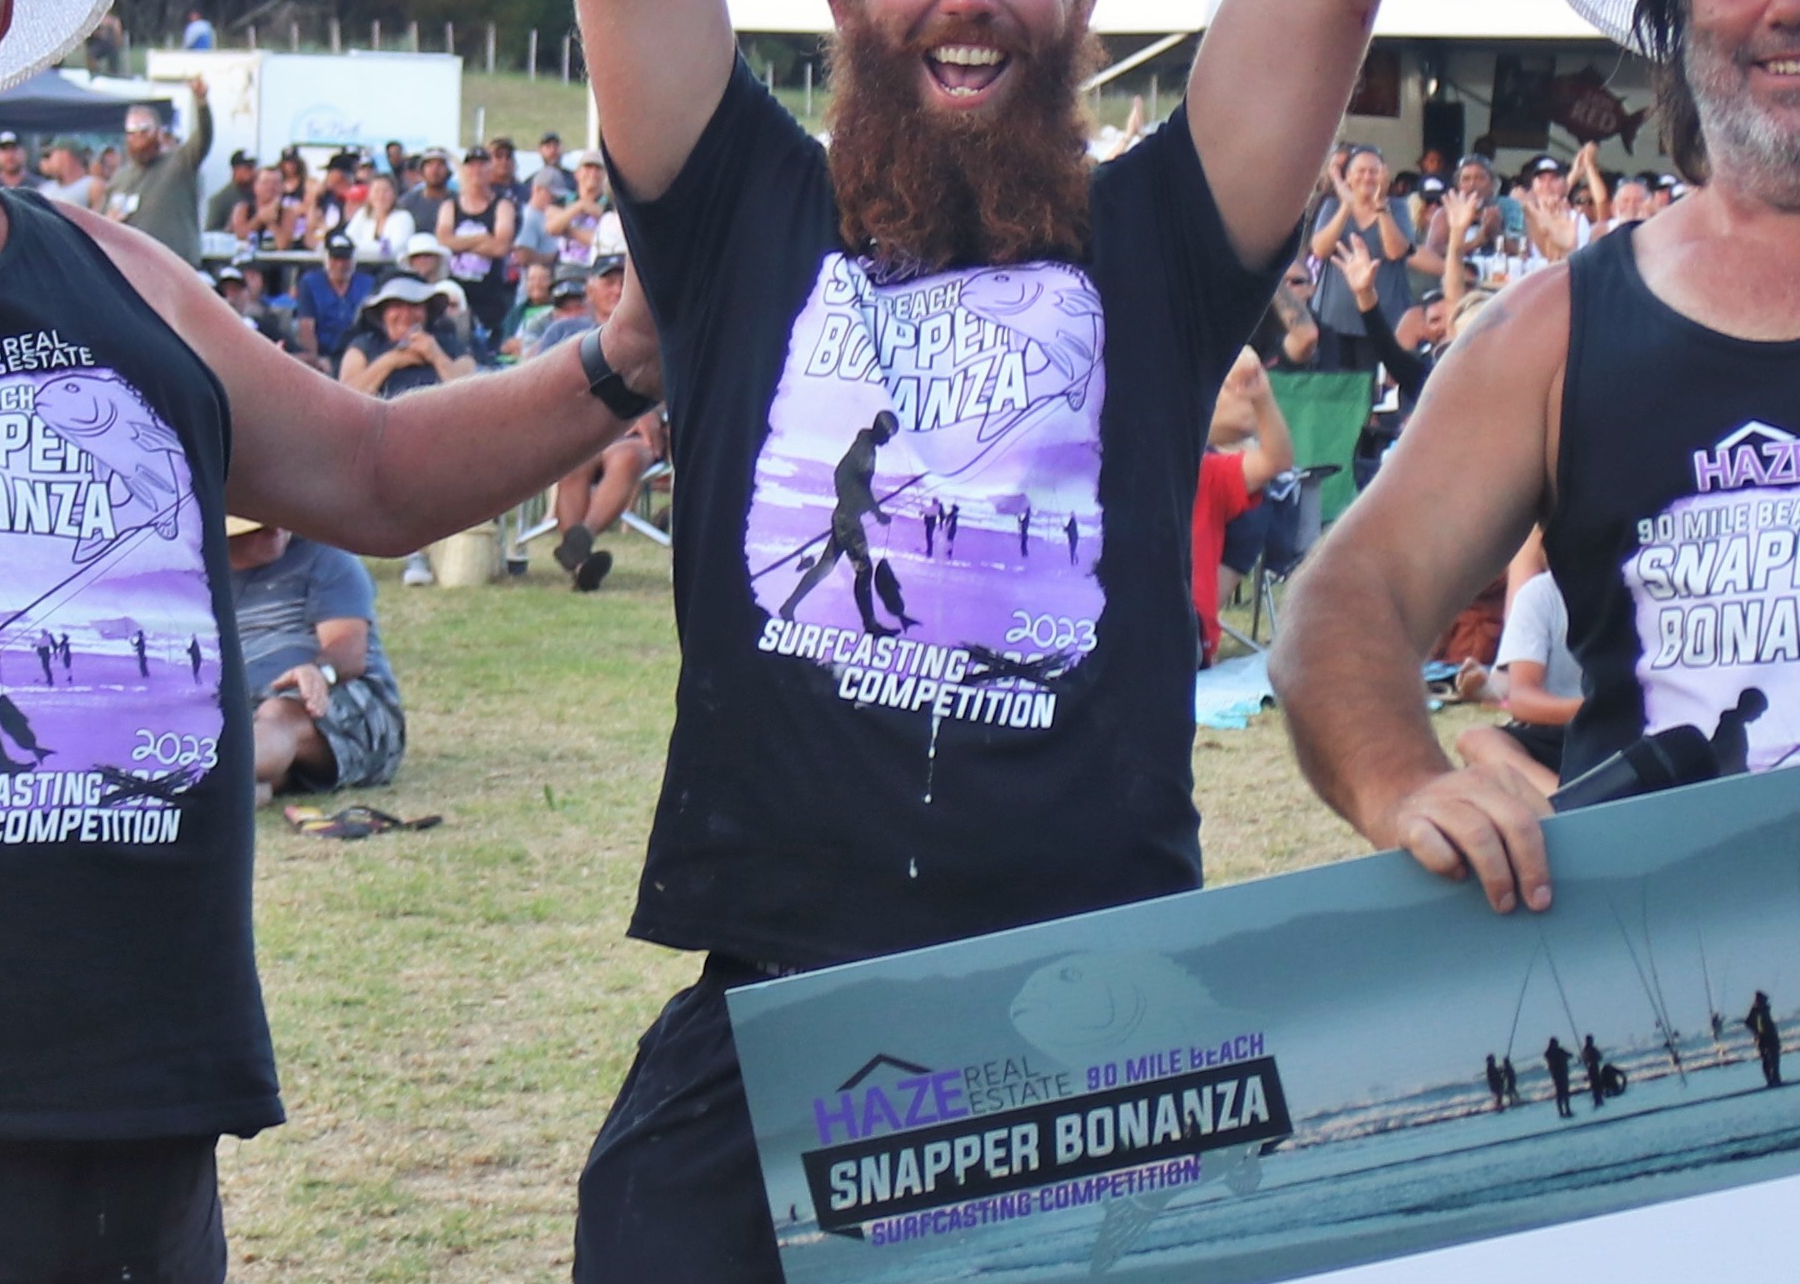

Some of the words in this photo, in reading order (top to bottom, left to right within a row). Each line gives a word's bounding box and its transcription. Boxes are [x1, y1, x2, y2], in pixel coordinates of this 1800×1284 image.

[4, 329, 69, 357] REAL
[7, 345, 95, 373] ESTATE
[805, 313, 1030, 433] BOANZA
[1637, 514, 1675, 545] 90
[1683, 502, 1749, 541] MILE
[757, 618, 971, 683] SURFCASTING
[1004, 610, 1098, 653] 2023
[838, 666, 1057, 730] COMPETITION
[130, 728, 219, 769] 2023
[965, 1055, 1041, 1088] REAL
[1086, 1062, 1117, 1092] 90
[1125, 1047, 1184, 1086] MILE
[1189, 1032, 1265, 1068] BEACH
[813, 1069, 969, 1145] HAZE
[970, 1071, 1074, 1114] ESTATE
[829, 1121, 1041, 1211] SNAPPER
[1055, 1074, 1270, 1167] BONANZA
[871, 1190, 1033, 1248] SURFCASTING
[1038, 1157, 1202, 1216] COMPETITION
